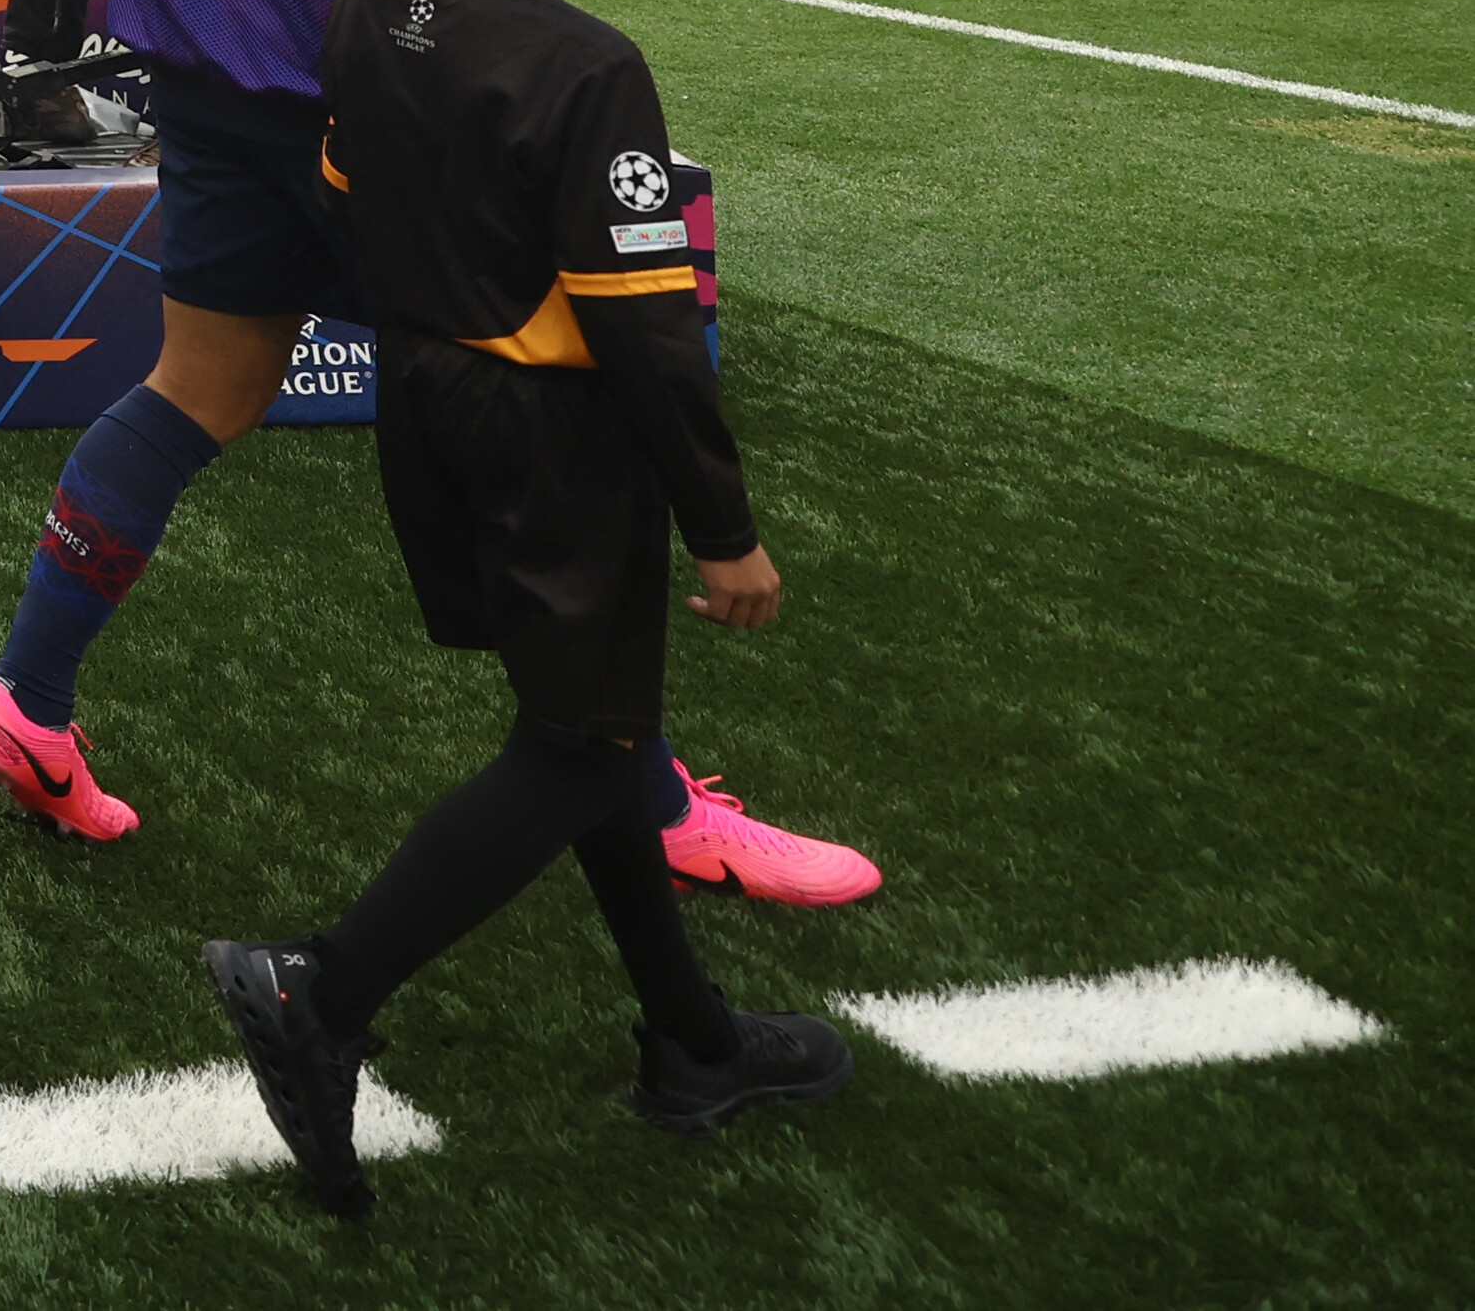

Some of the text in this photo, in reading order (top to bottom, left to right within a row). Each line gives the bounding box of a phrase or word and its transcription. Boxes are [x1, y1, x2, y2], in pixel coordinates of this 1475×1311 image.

[388, 27, 435, 49] CHAMPIONS
[396, 38, 425, 53] LEAGUE
[617, 230, 686, 243] FOUNDATION
[280, 371, 364, 395] AGUE
